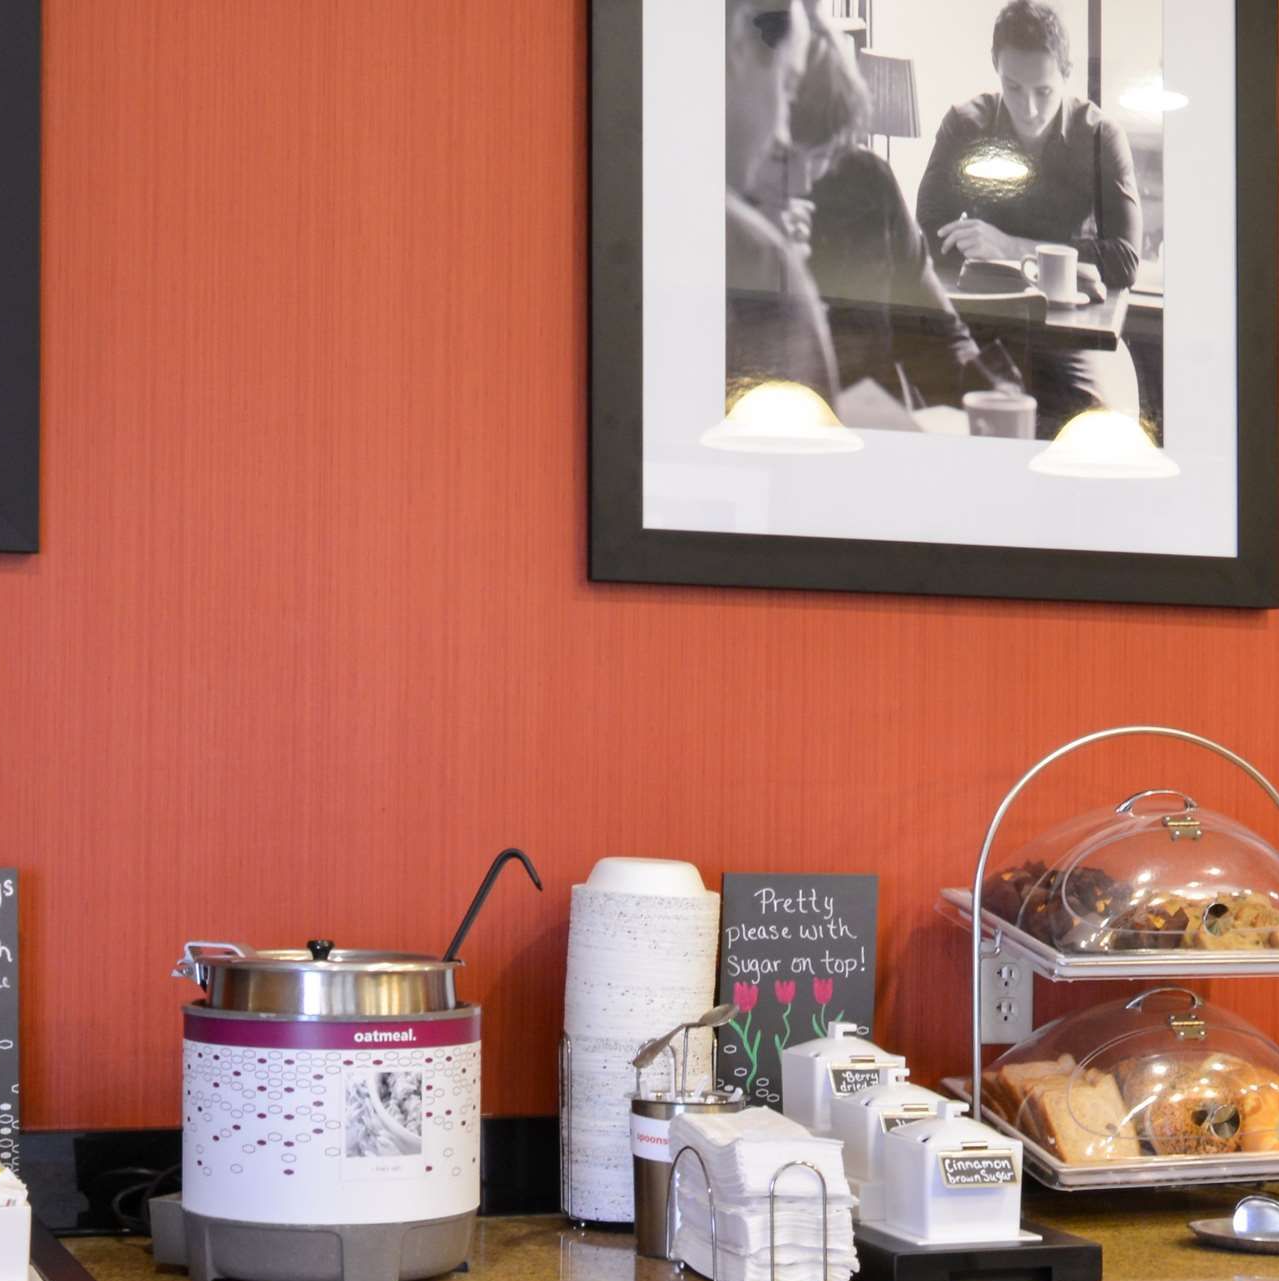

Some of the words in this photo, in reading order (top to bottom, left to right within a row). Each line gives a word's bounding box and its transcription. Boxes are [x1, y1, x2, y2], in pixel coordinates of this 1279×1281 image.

[754, 888, 834, 920] Pretty
[726, 923, 792, 949] please
[800, 917, 857, 941] with
[791, 957, 815, 975] on
[821, 946, 865, 978] top!
[354, 1028, 417, 1043] oatmeal.
[842, 1071, 879, 1086] Berry
[944, 1158, 1011, 1173] Cinnamon
[947, 1171, 981, 1184] brown
